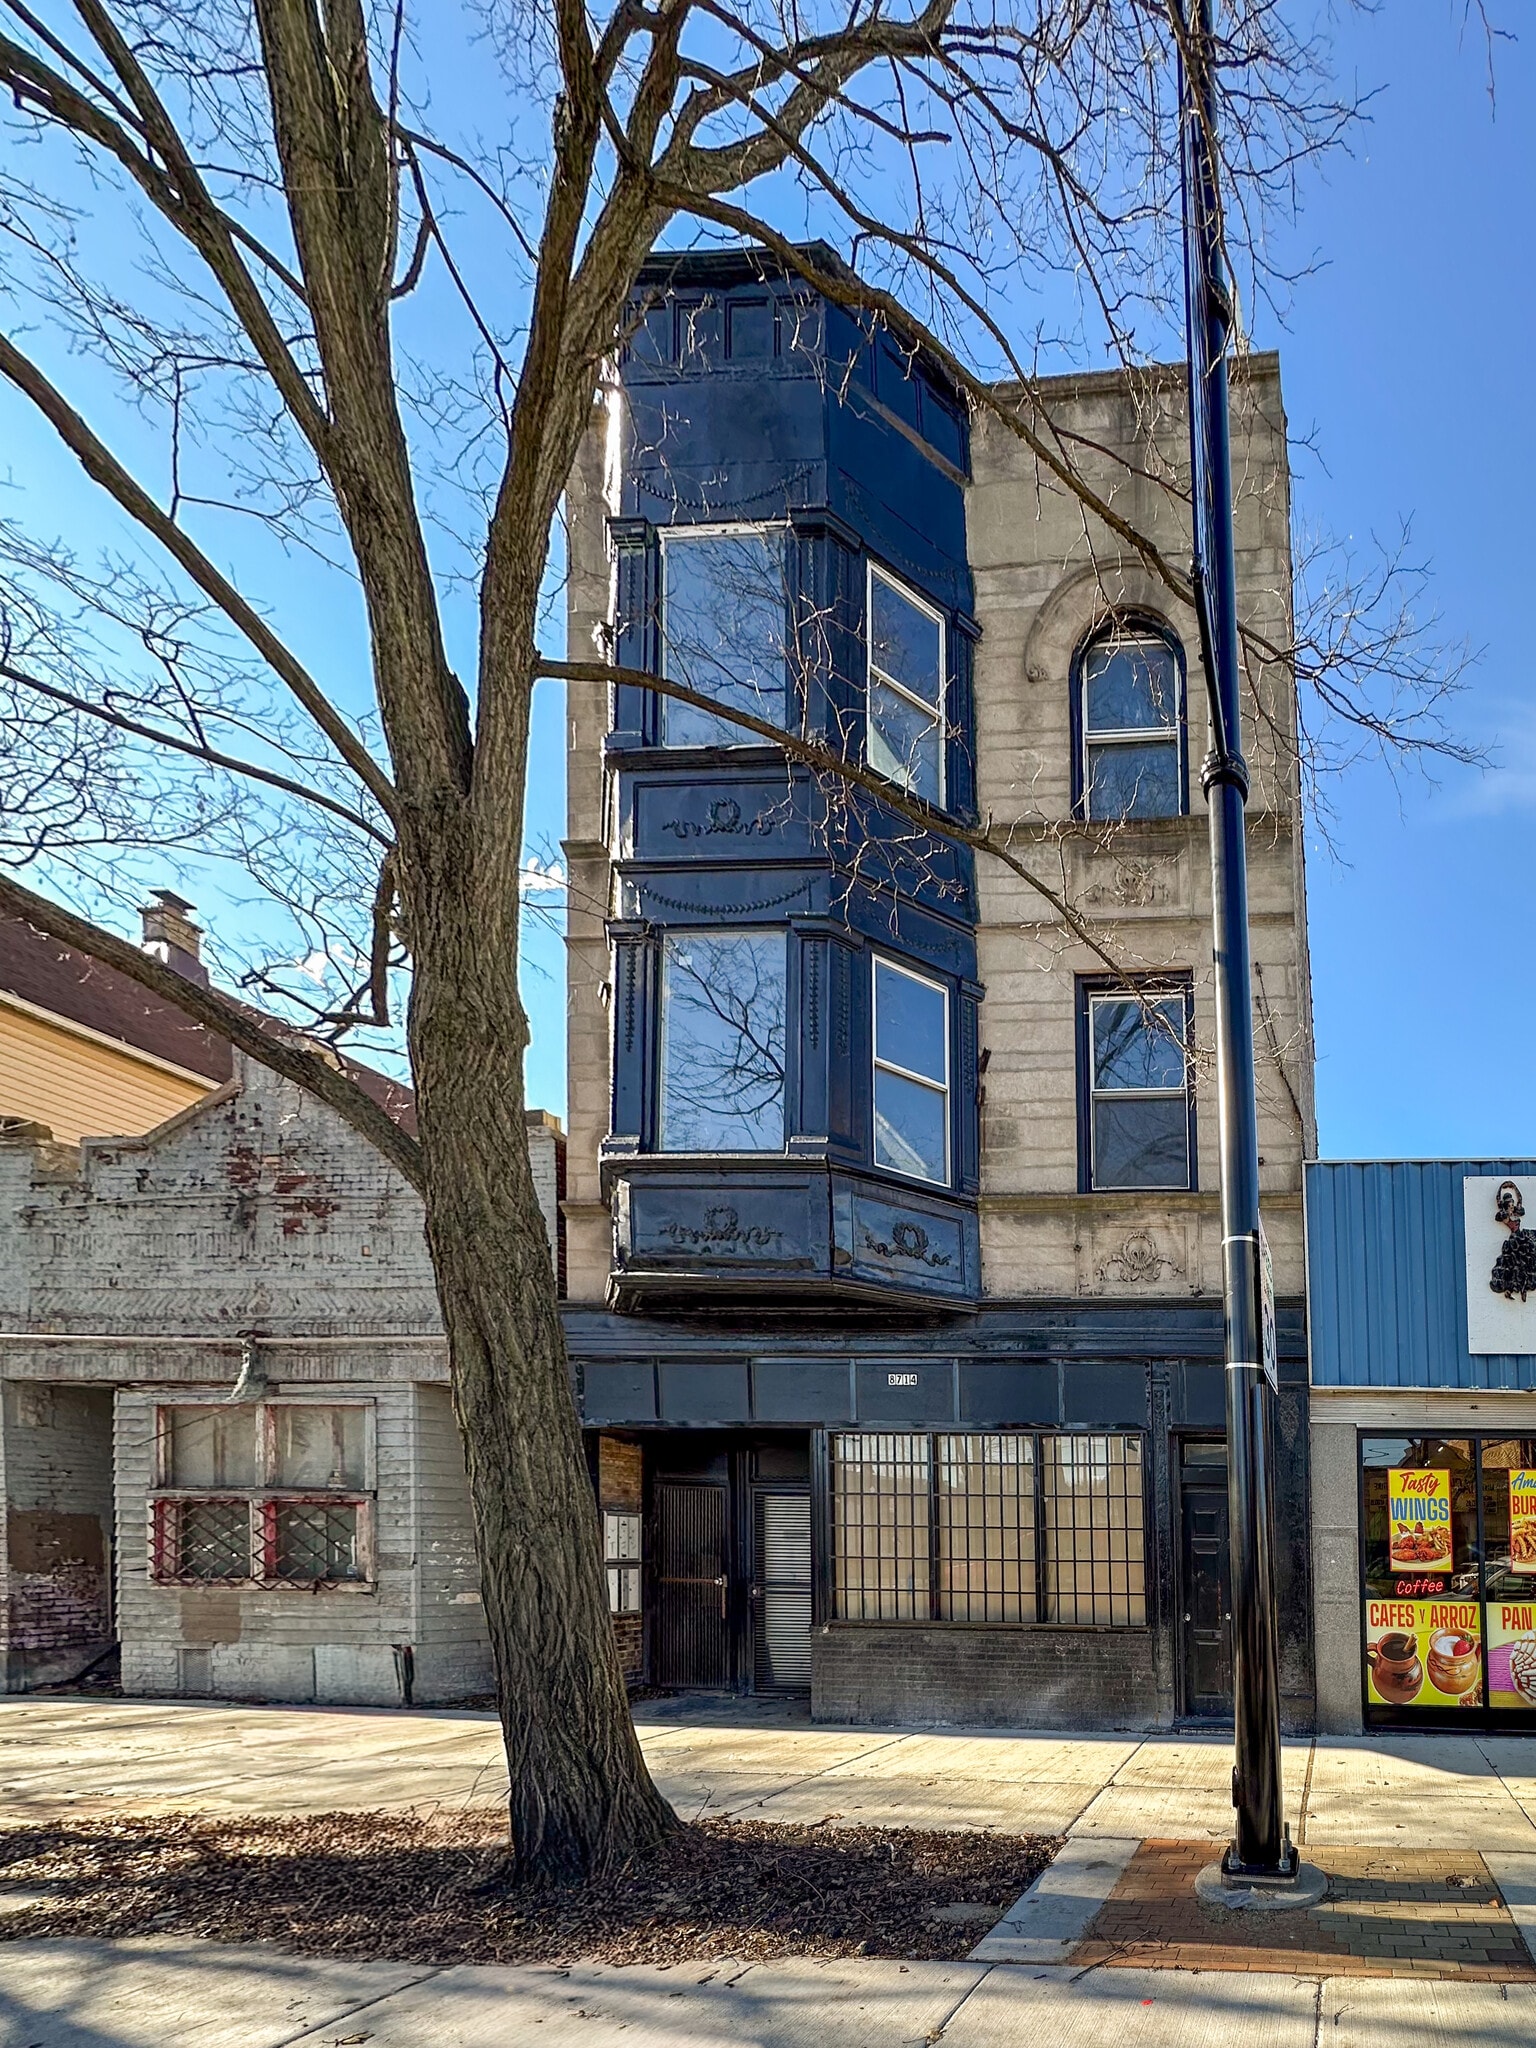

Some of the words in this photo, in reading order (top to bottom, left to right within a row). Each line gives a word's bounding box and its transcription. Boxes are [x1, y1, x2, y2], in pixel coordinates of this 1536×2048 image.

[889, 1375, 916, 1385] 8714
[1400, 1471, 1441, 1497] Tasty
[1390, 1497, 1449, 1521] WINGS
[1512, 1495, 1536, 1515] BUR
[1397, 1578, 1444, 1595] Coffee
[1370, 1603, 1415, 1628] CAFES
[1419, 1608, 1426, 1624] Y
[1429, 1604, 1477, 1629] ARROZ
[1501, 1606, 1533, 1631] PAN
